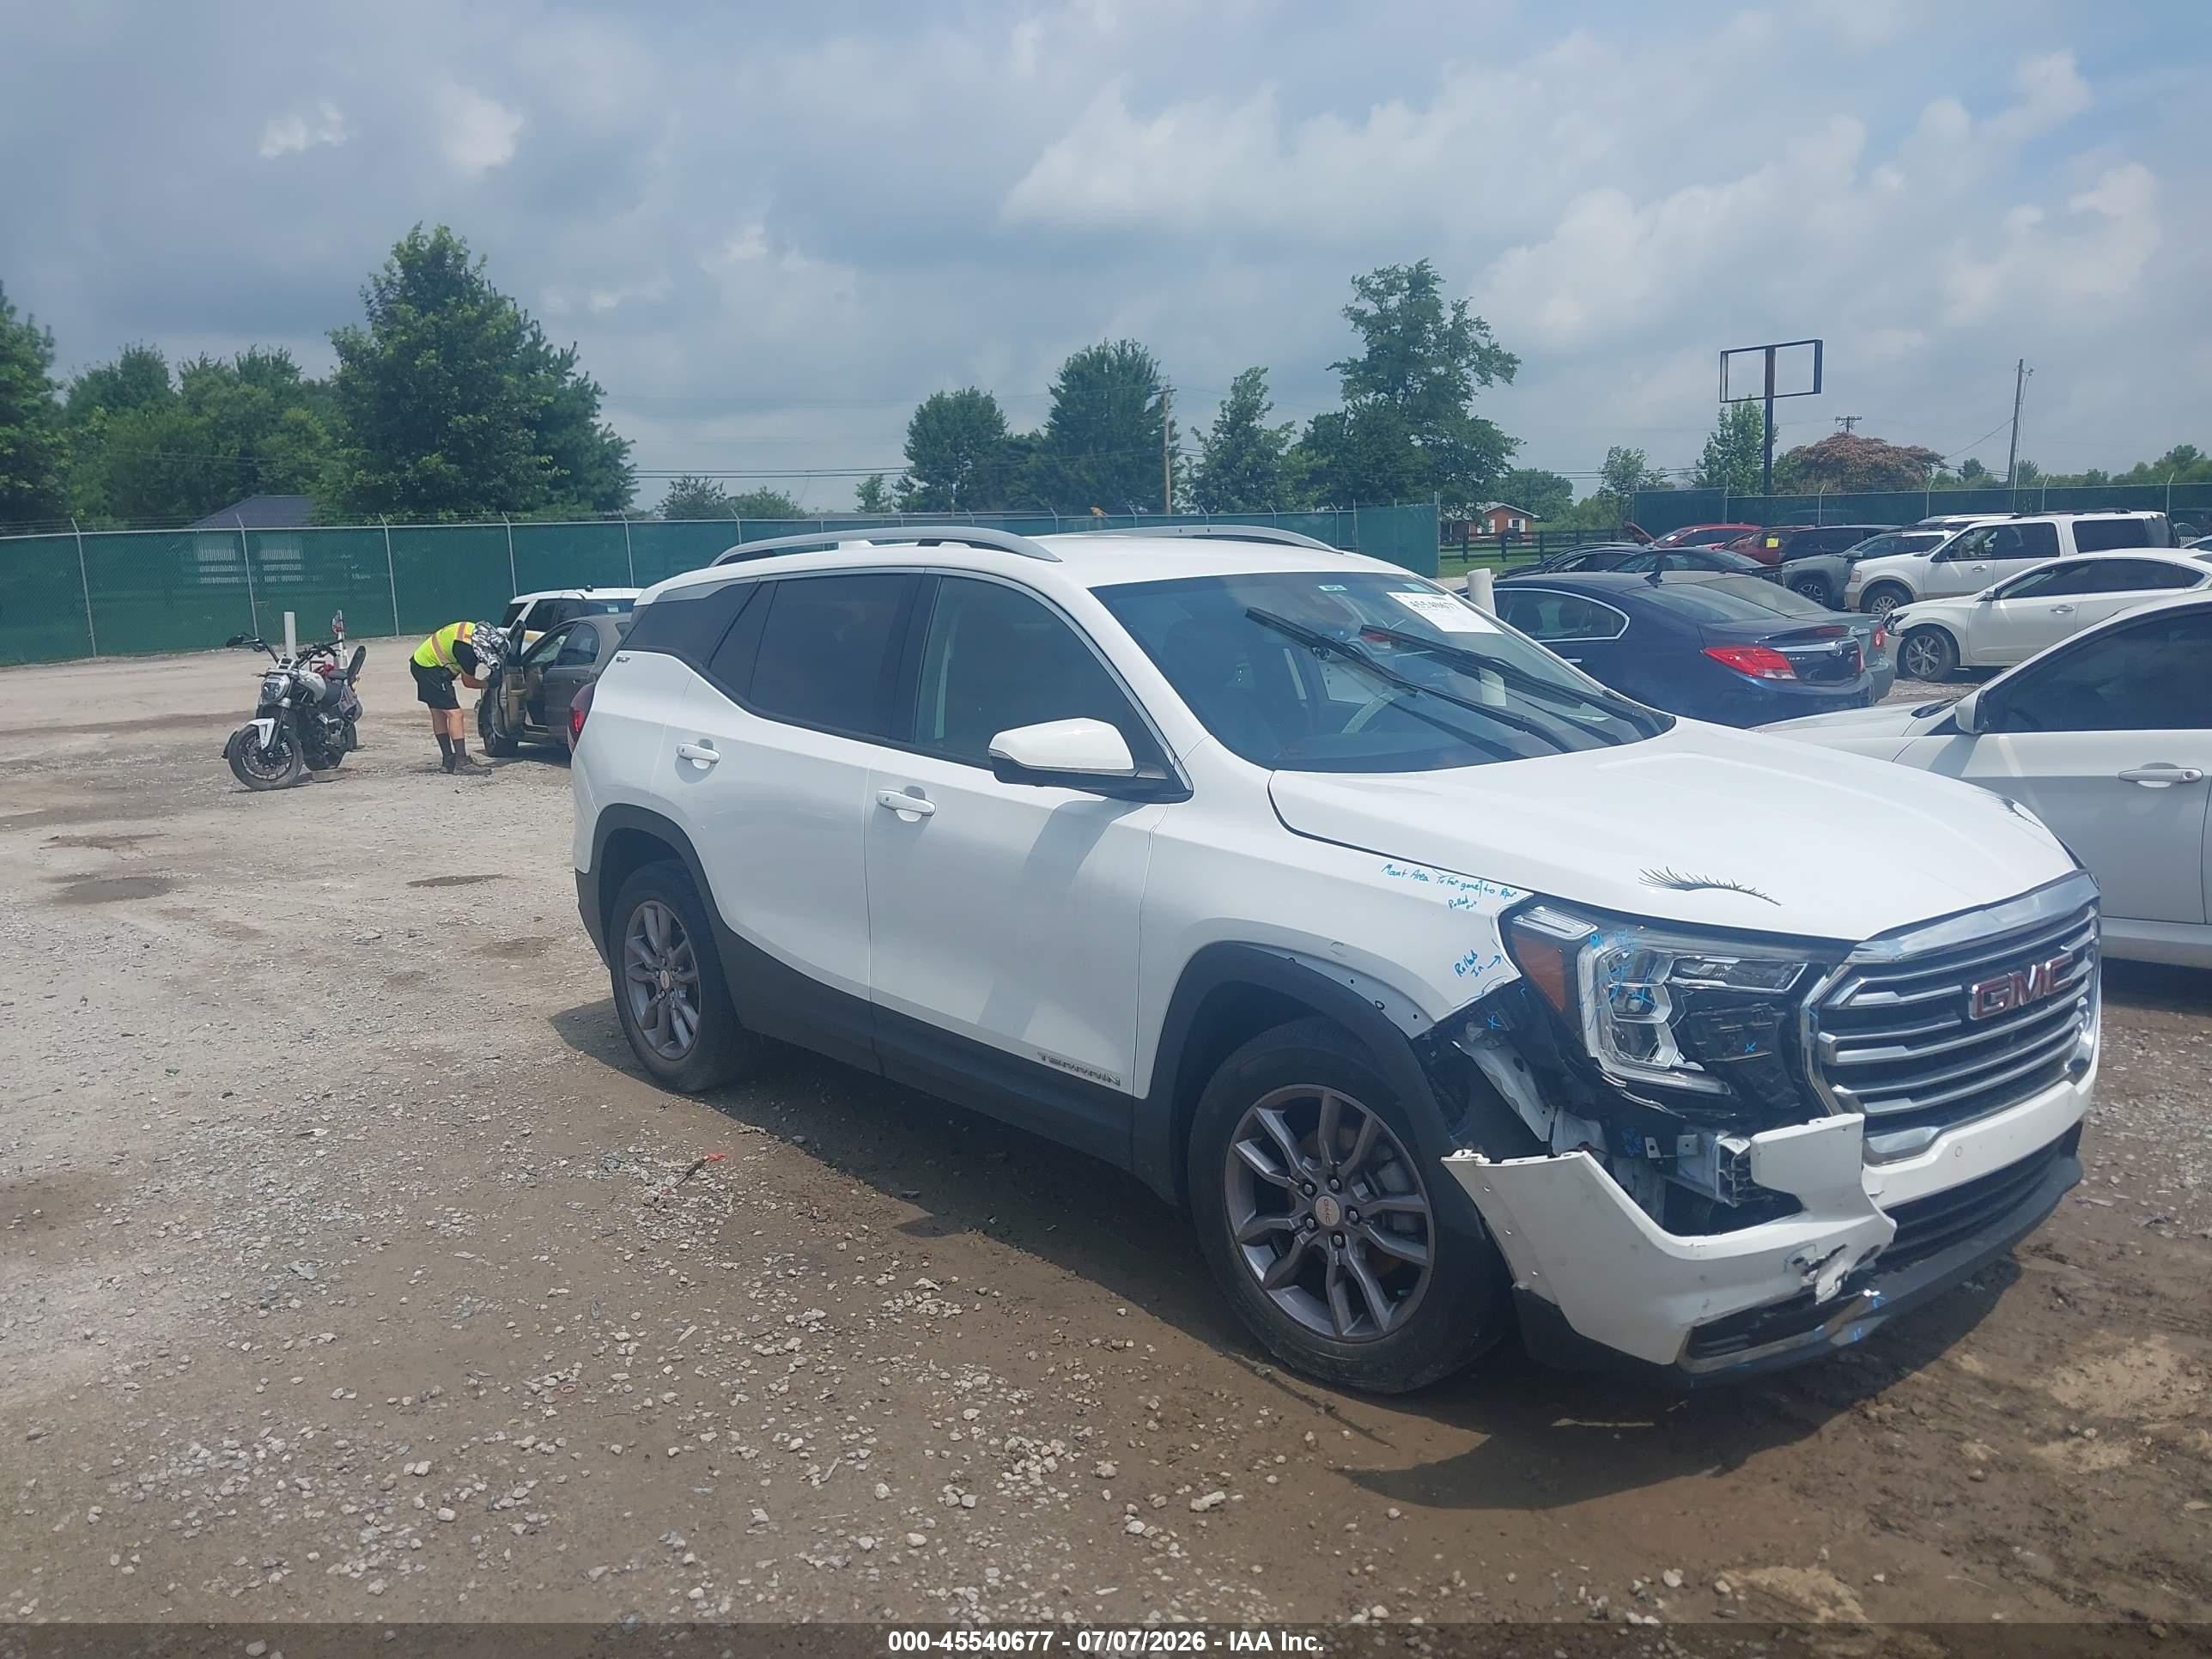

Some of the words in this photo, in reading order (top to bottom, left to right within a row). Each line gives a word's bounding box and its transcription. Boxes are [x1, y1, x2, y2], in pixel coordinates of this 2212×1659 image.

[1410, 869, 1429, 882] Area
[1484, 883, 1495, 894] to
[1969, 951, 2073, 1020] GMC
